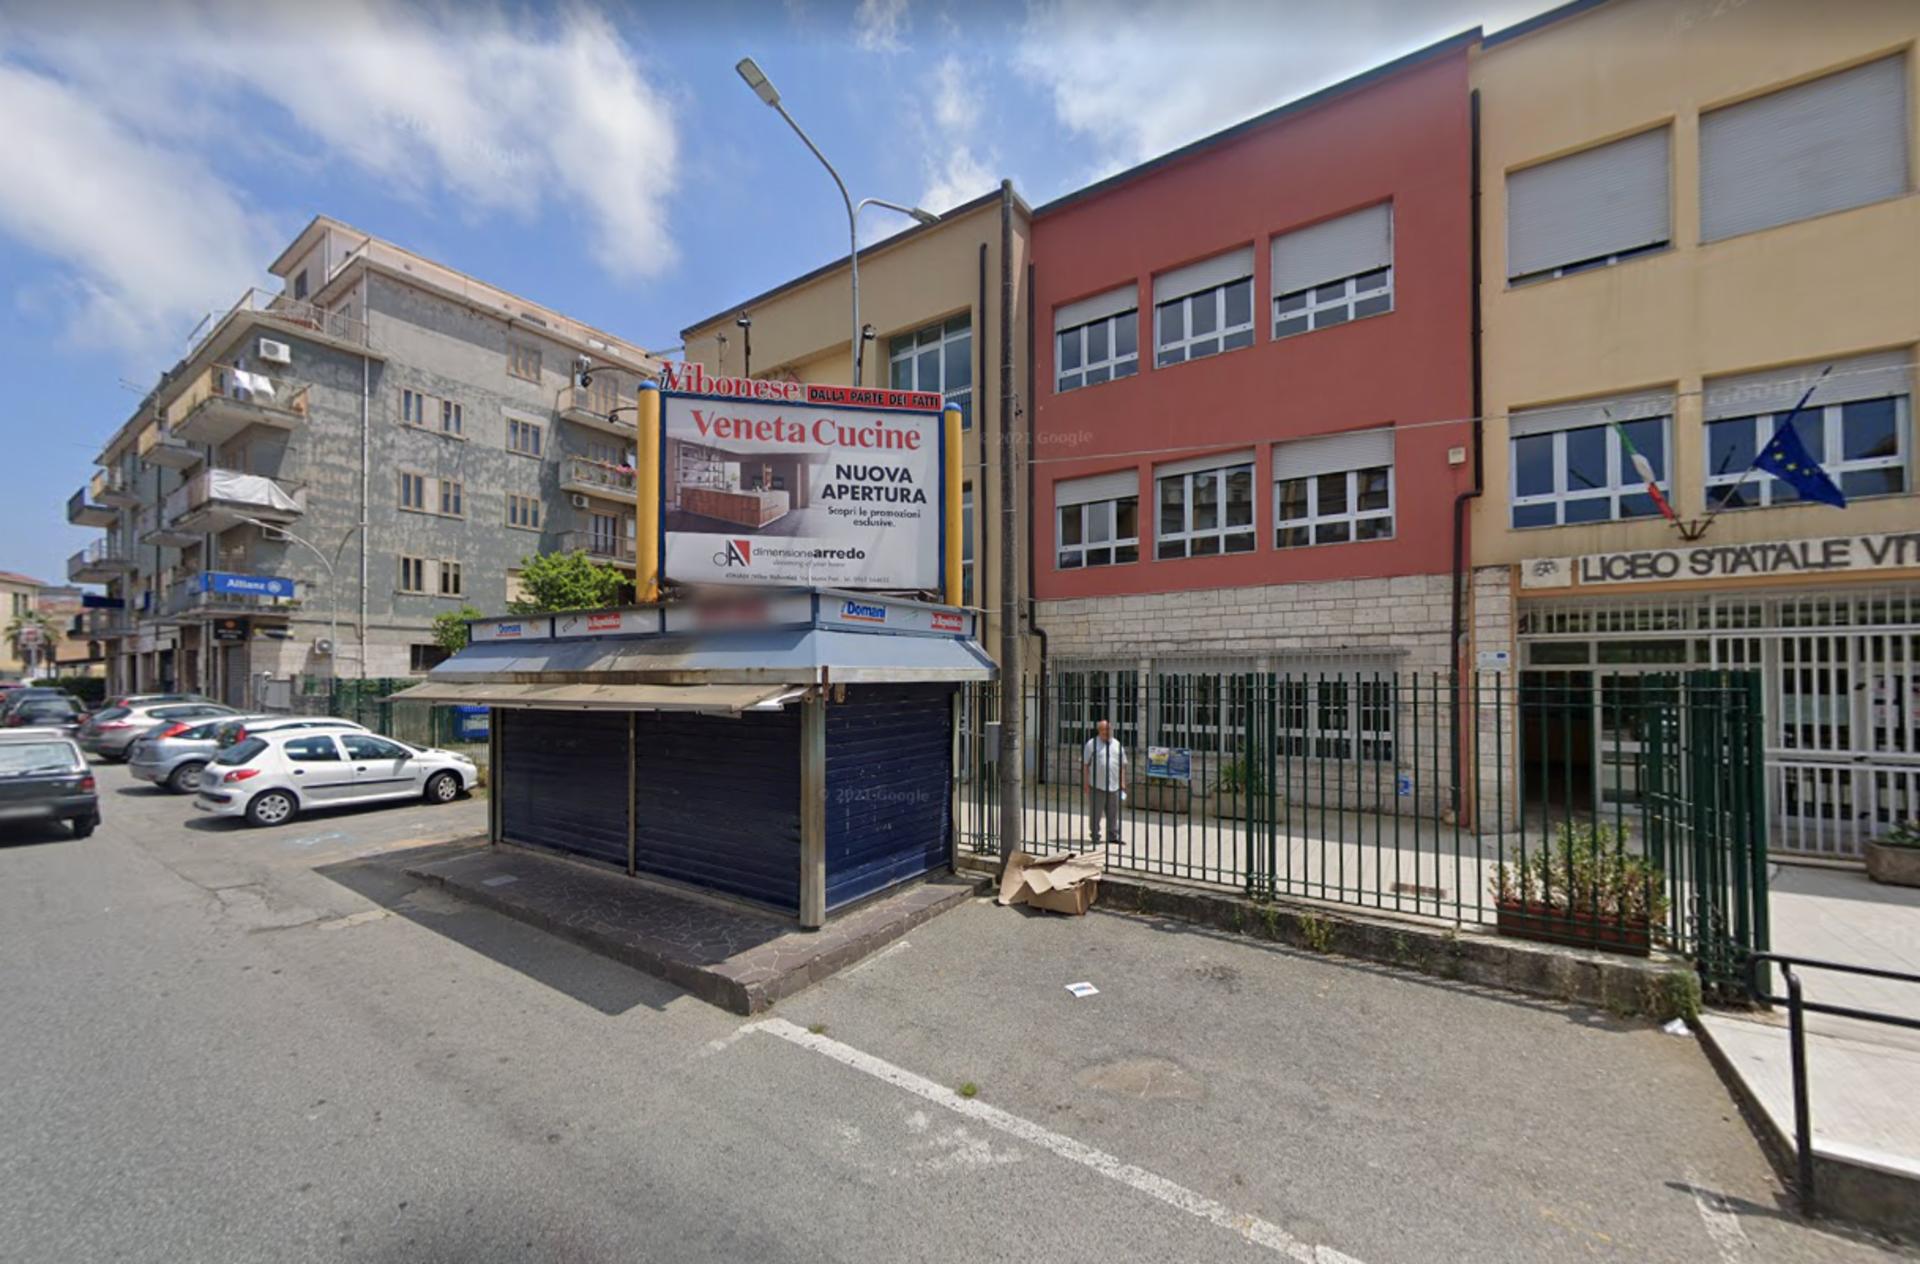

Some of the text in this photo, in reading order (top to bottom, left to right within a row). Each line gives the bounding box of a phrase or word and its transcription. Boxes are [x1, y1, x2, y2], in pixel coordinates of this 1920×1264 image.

[662, 361, 798, 399] Vibonese
[810, 388, 939, 407] DALLA PARTE DEI FATTI
[691, 410, 921, 450] Veneta Cucine
[835, 464, 913, 484] NUOVA
[821, 484, 928, 504] APERTURA
[828, 506, 921, 519] Scopri le promozioni
[1582, 551, 1680, 582] LICEO
[1690, 539, 1851, 576] STATALE
[226, 579, 266, 590] Allianz
[847, 601, 886, 618] Domani
